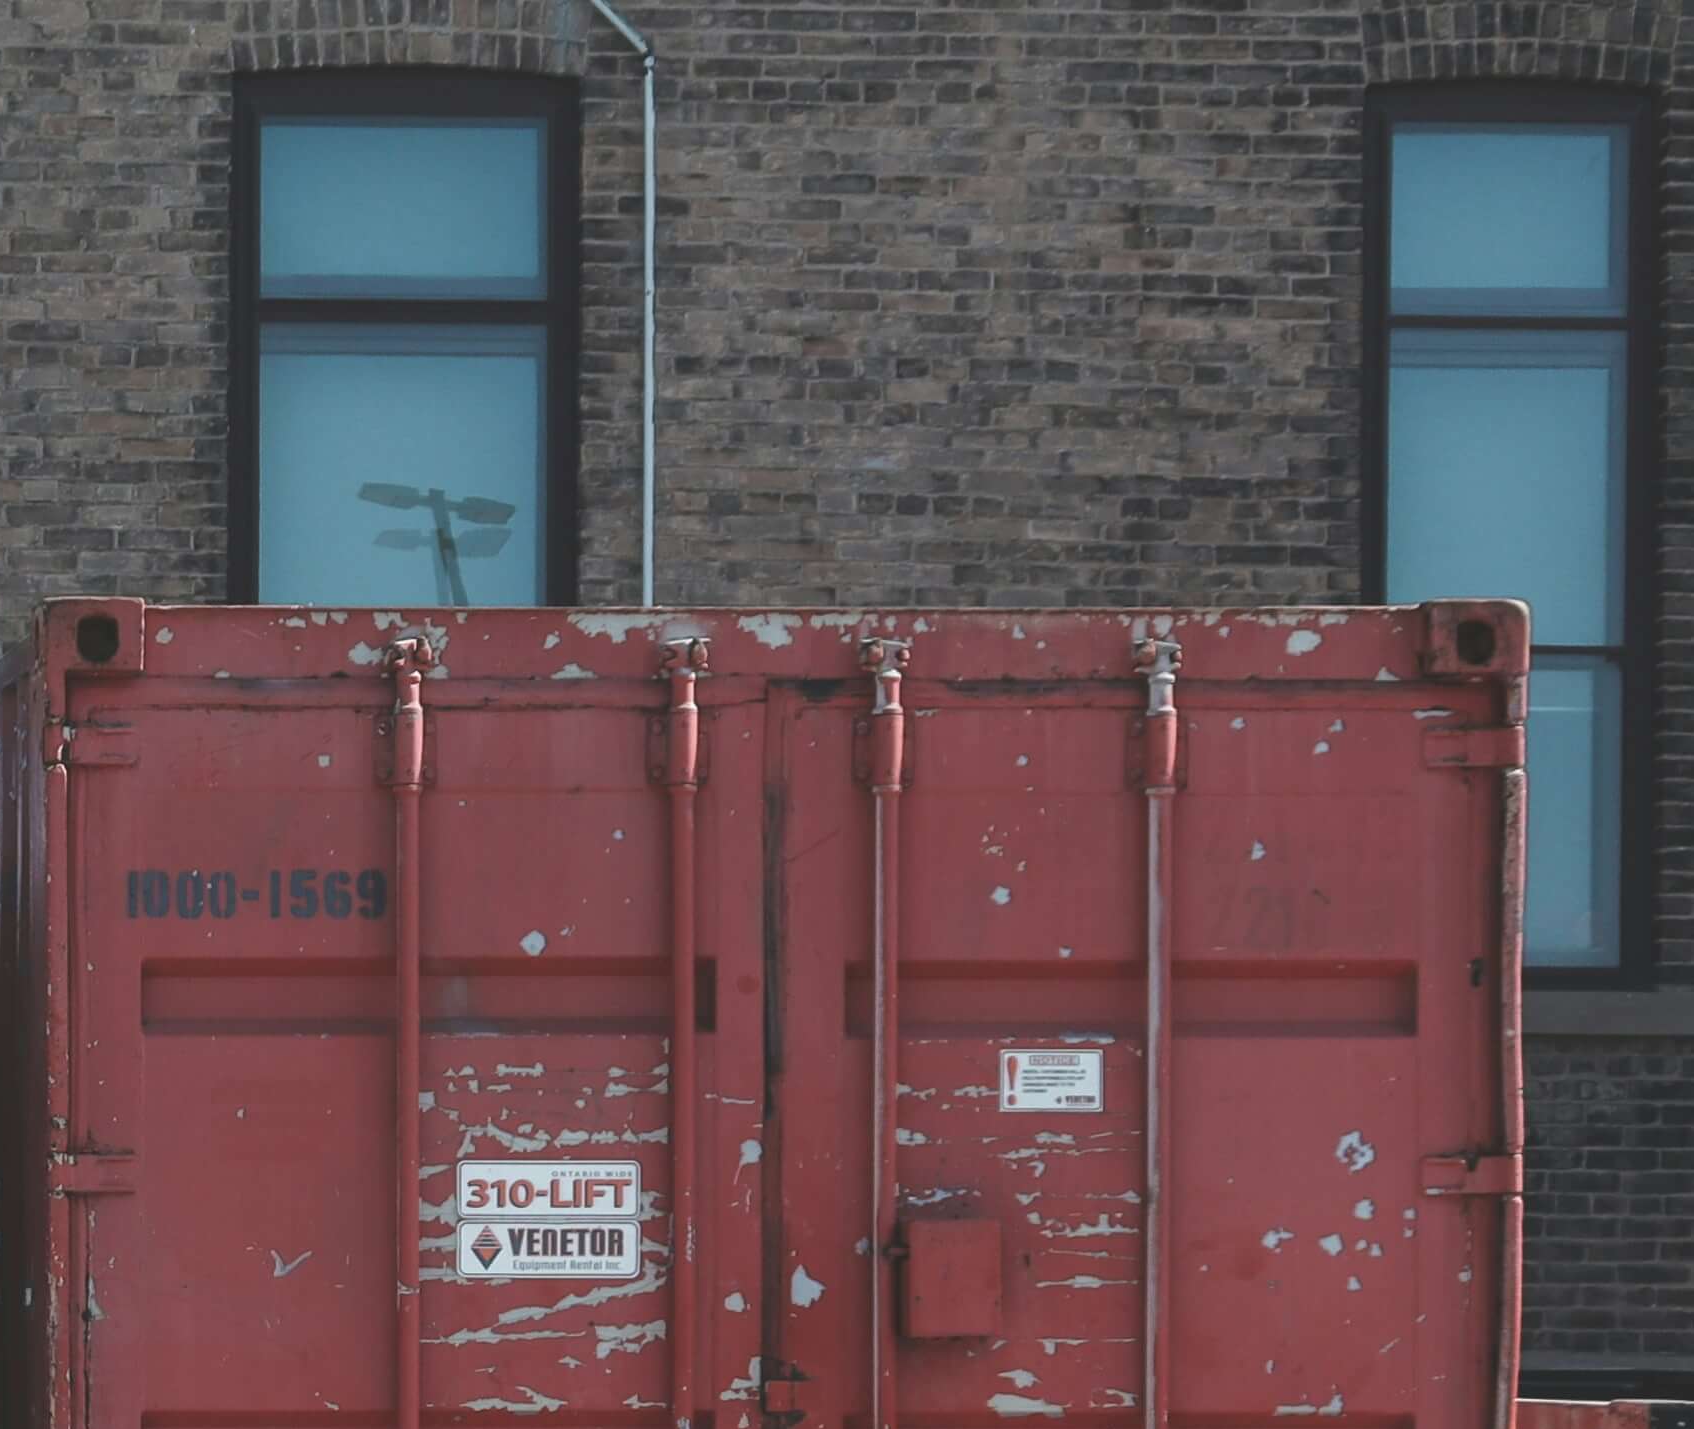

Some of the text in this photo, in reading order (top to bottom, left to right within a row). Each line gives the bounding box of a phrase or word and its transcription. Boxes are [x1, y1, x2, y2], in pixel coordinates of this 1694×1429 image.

[127, 869, 387, 920] 1000-1569
[466, 1179, 632, 1209] 310-LIFT
[507, 1228, 624, 1257] VENETOR
[513, 1260, 566, 1271] Equipment
[570, 1260, 602, 1270] Rental
